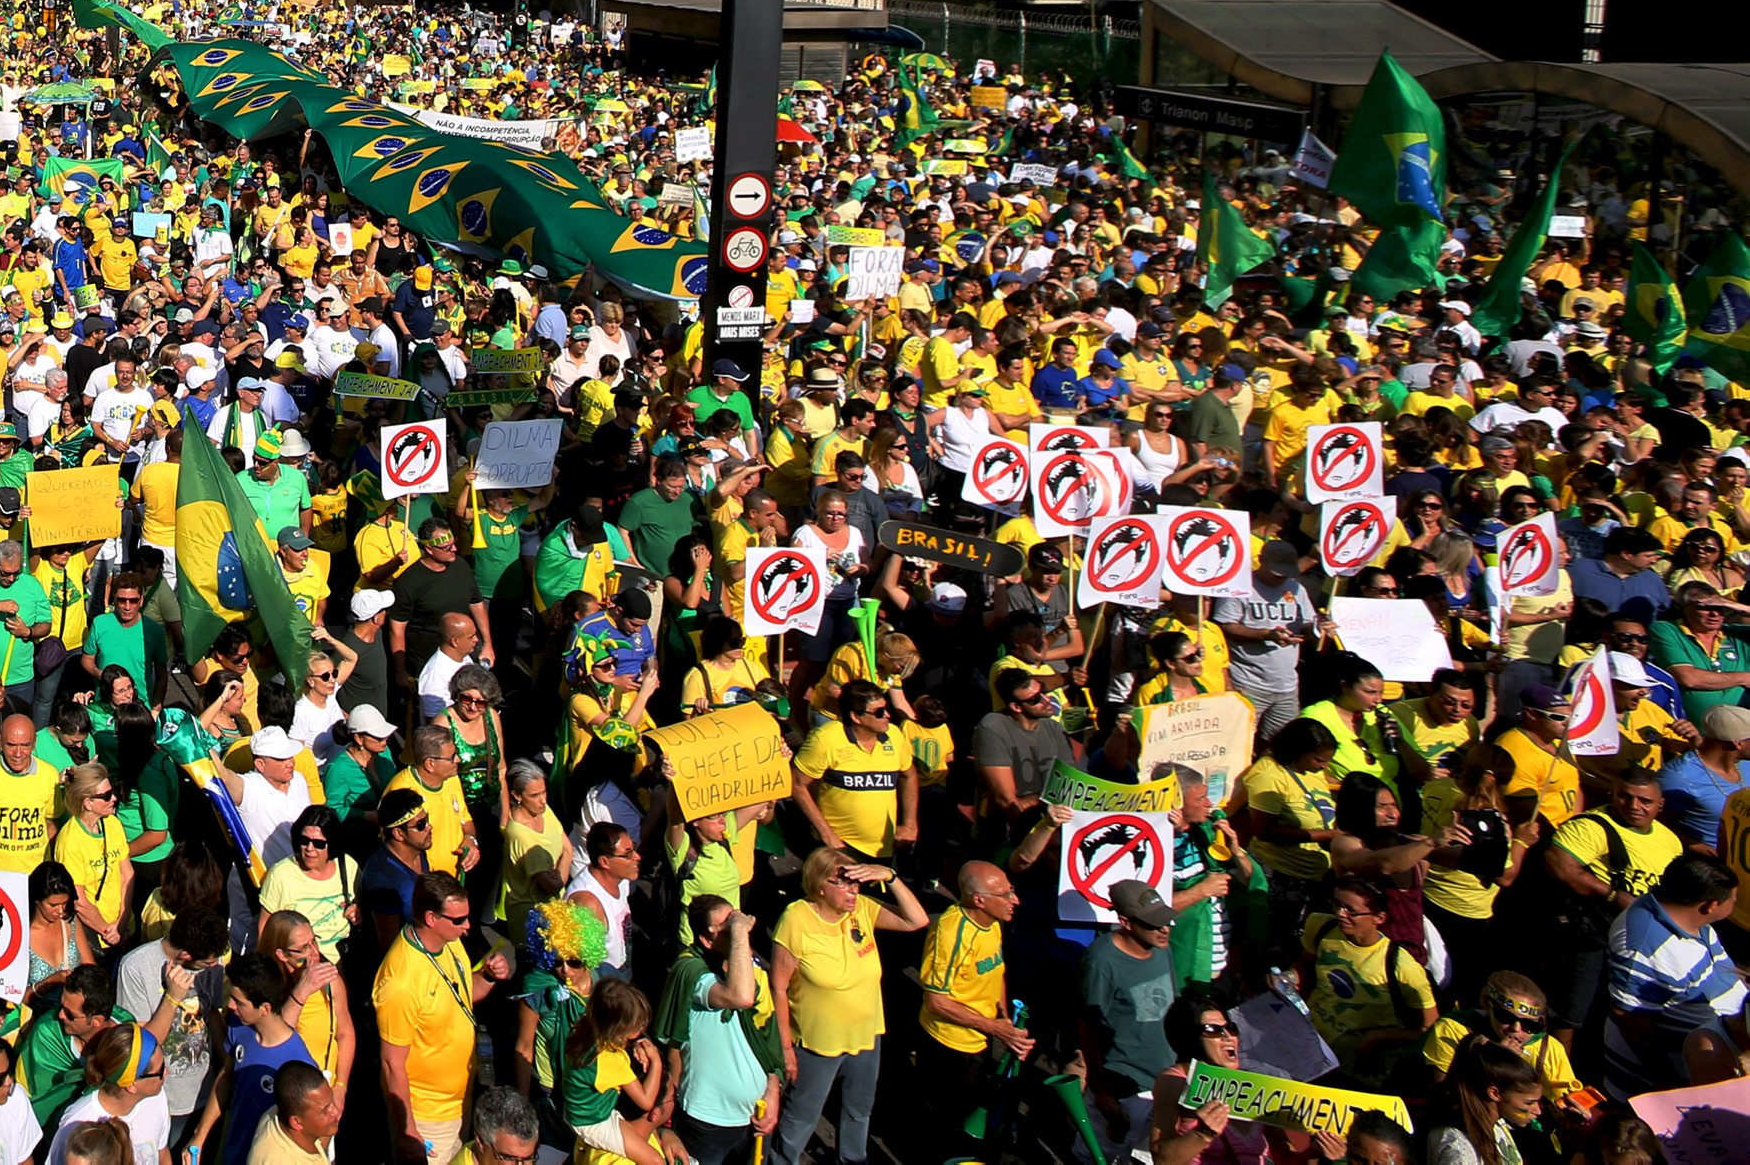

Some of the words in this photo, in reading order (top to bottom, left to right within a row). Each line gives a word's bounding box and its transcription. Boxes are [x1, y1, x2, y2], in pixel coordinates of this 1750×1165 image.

[435, 119, 455, 129] NÃO
[495, 135, 541, 144] CORRUPÇÃO
[850, 249, 900, 274] FORA
[847, 274, 896, 298] DILMA
[721, 311, 742, 320] MENOS
[720, 325, 738, 338] MAIS
[339, 376, 397, 394] IMPEACHMENT
[485, 425, 552, 451] DILMA
[475, 460, 553, 484] CORRUPTA
[34, 472, 112, 493] QUEREMOS
[1118, 592, 1138, 601] Fora
[1210, 587, 1230, 595] Fora
[1248, 602, 1294, 622] UCL
[1171, 716, 1219, 735] ARMADA
[680, 741, 742, 780] CHEFE
[753, 733, 781, 765] DA
[685, 770, 785, 811] QUADRILHA
[843, 774, 894, 788] BRAZIL
[1048, 771, 1170, 812] IMPEACHMENT
[0, 807, 41, 825] FORA
[5, 985, 23, 995] Dilma
[1196, 1072, 1356, 1135] IMPEACHMENT
